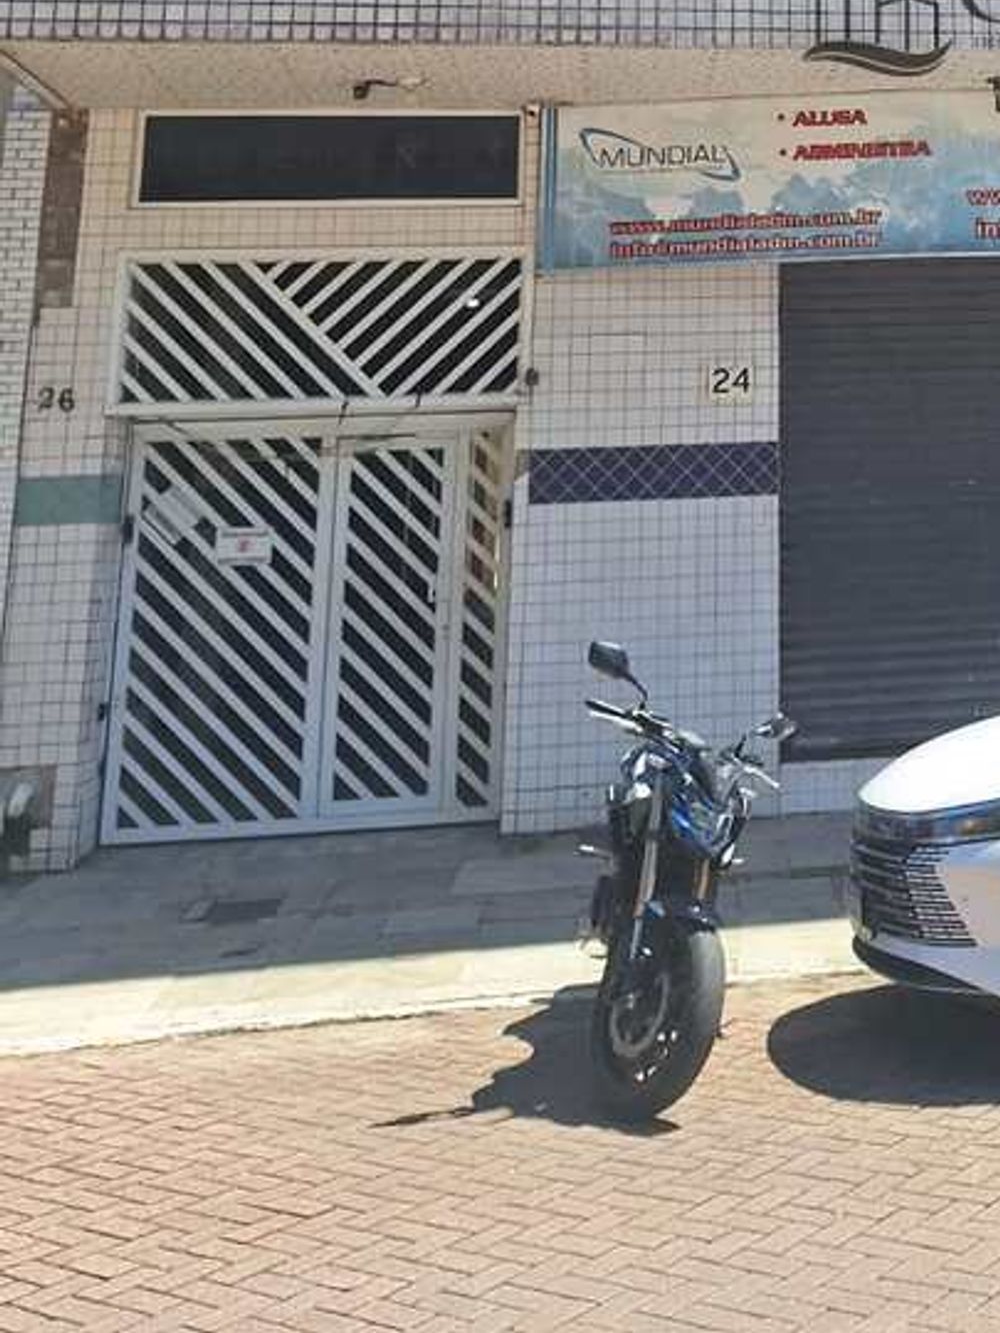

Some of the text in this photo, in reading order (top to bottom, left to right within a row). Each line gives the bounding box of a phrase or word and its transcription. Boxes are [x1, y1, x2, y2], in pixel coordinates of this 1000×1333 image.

[598, 143, 727, 168] MUNDIAL
[712, 367, 750, 394] 24
[37, 386, 76, 413] 26
